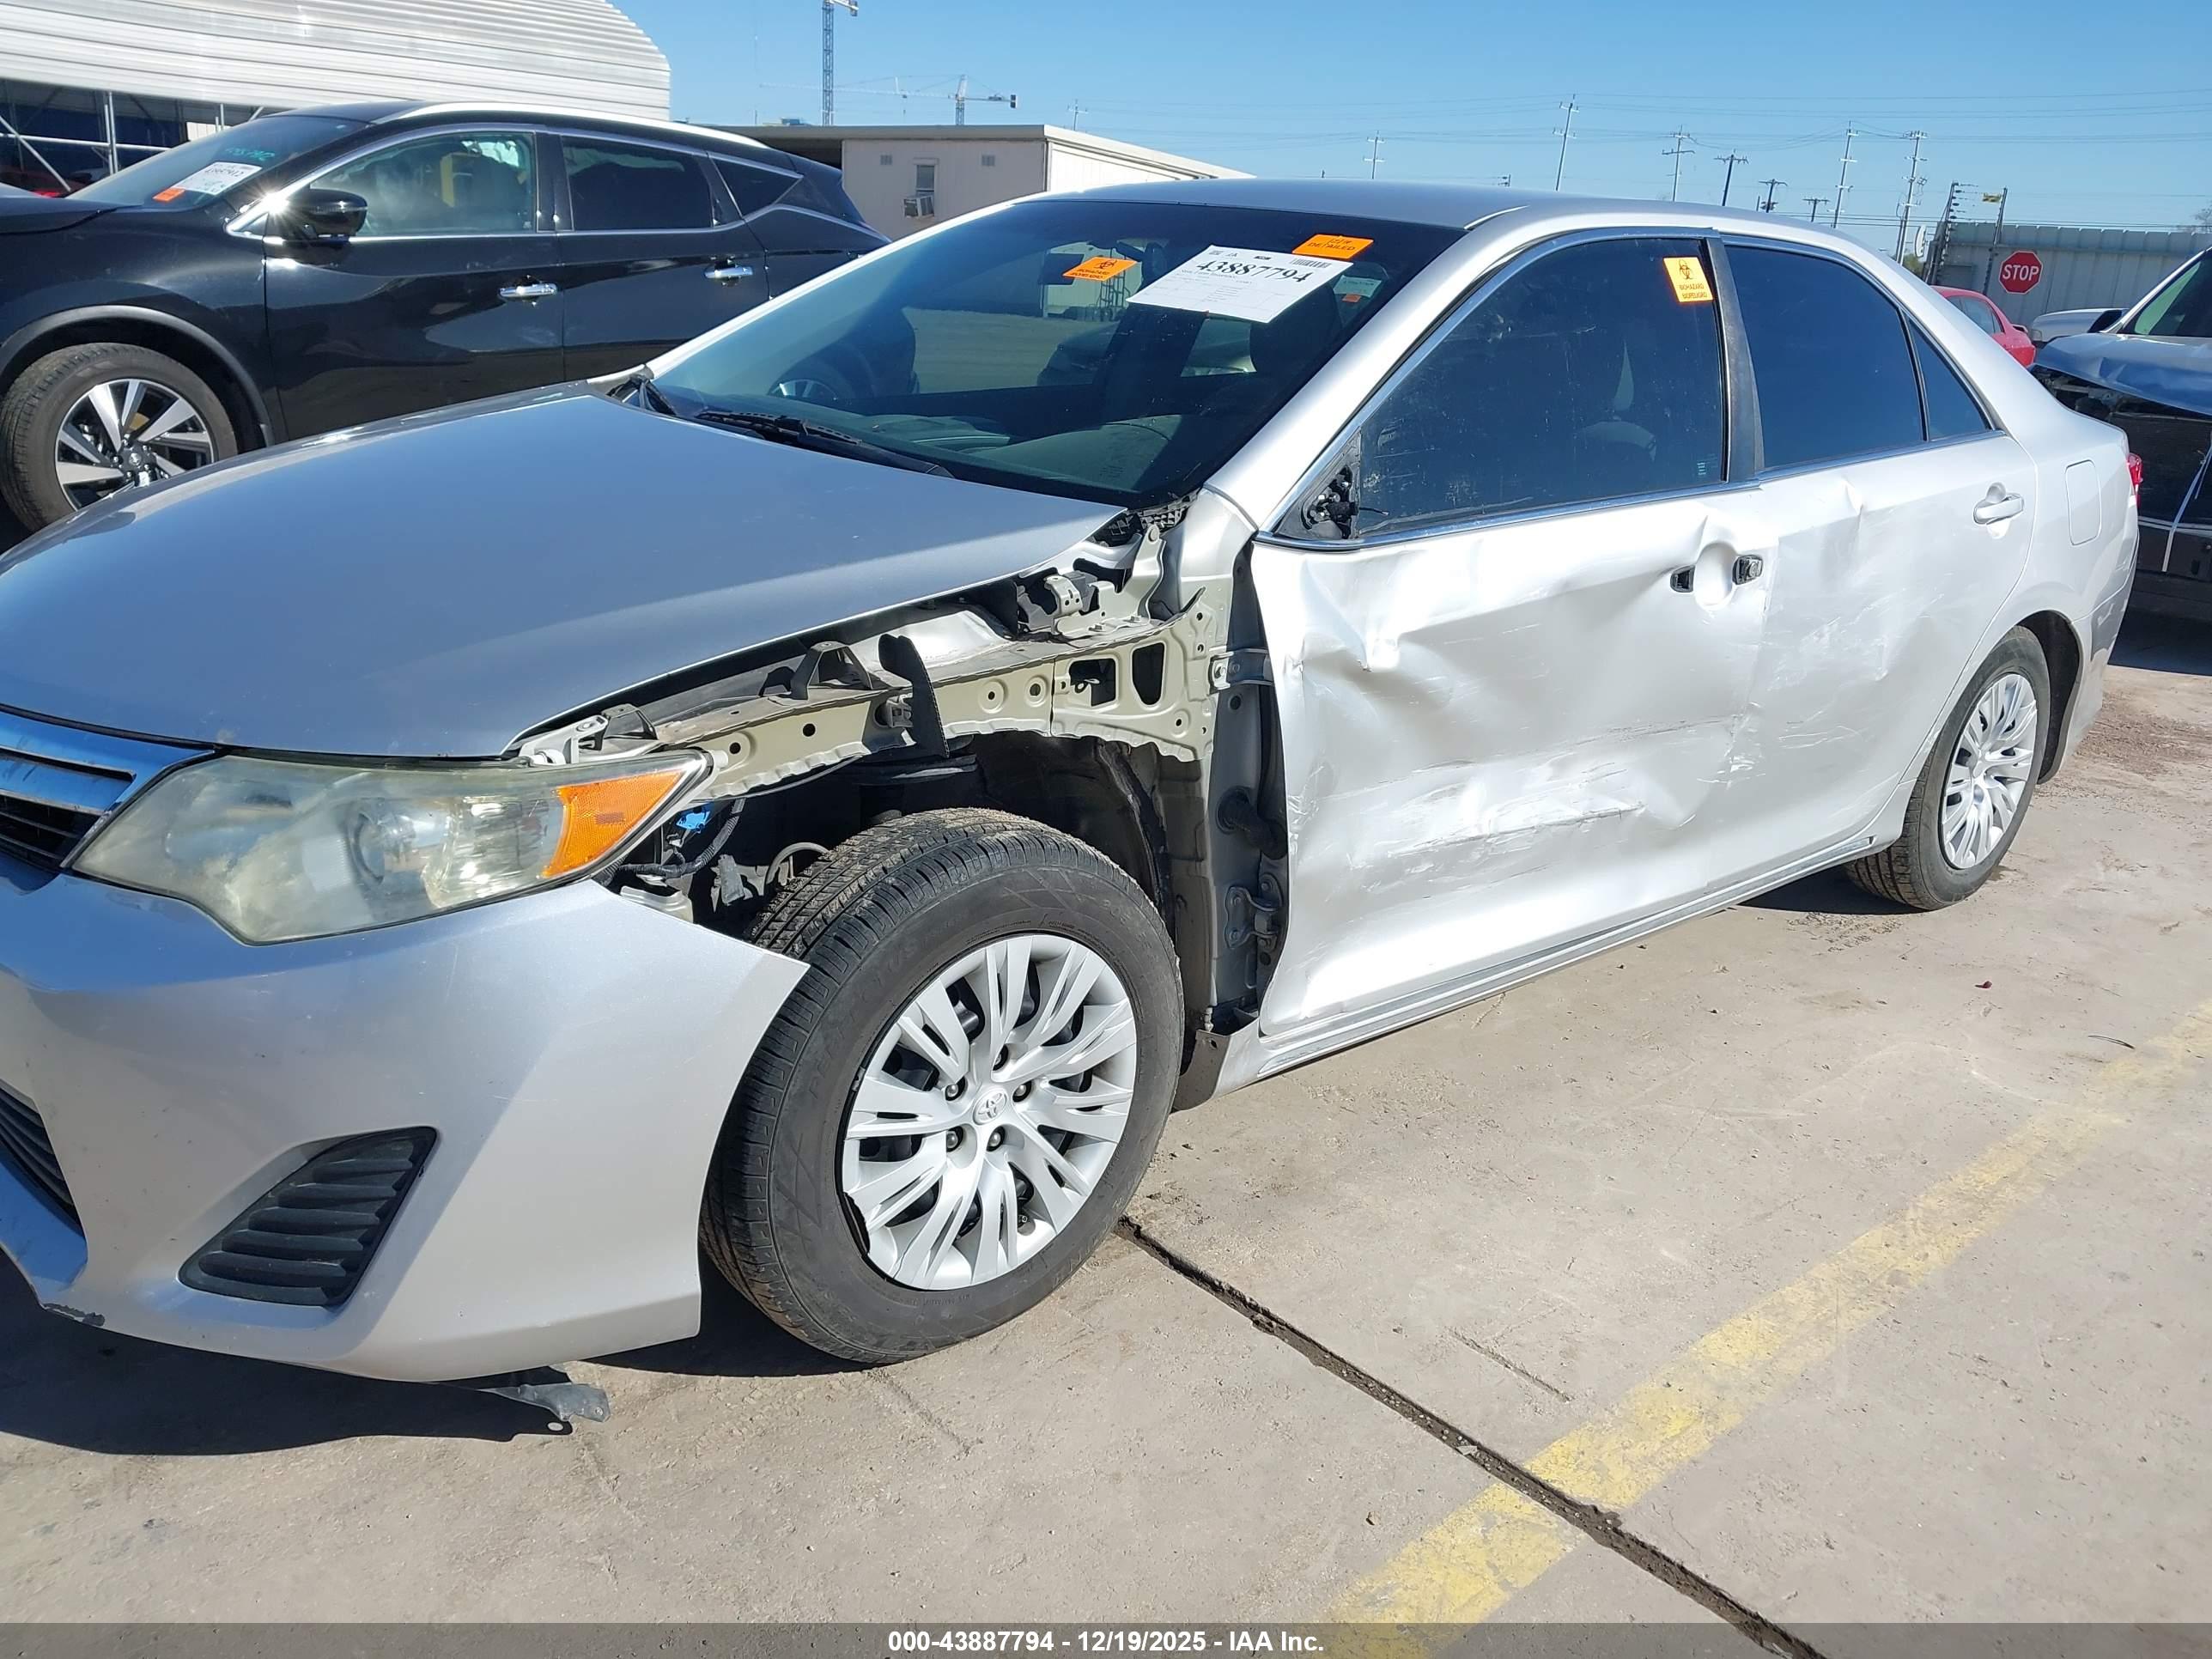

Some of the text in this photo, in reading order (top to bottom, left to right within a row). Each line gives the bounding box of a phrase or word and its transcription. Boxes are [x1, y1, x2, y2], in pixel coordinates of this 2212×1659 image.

[1307, 242, 1356, 251] DETAILED
[1196, 260, 1315, 283] 43887794
[2002, 264, 2039, 282] STOP
